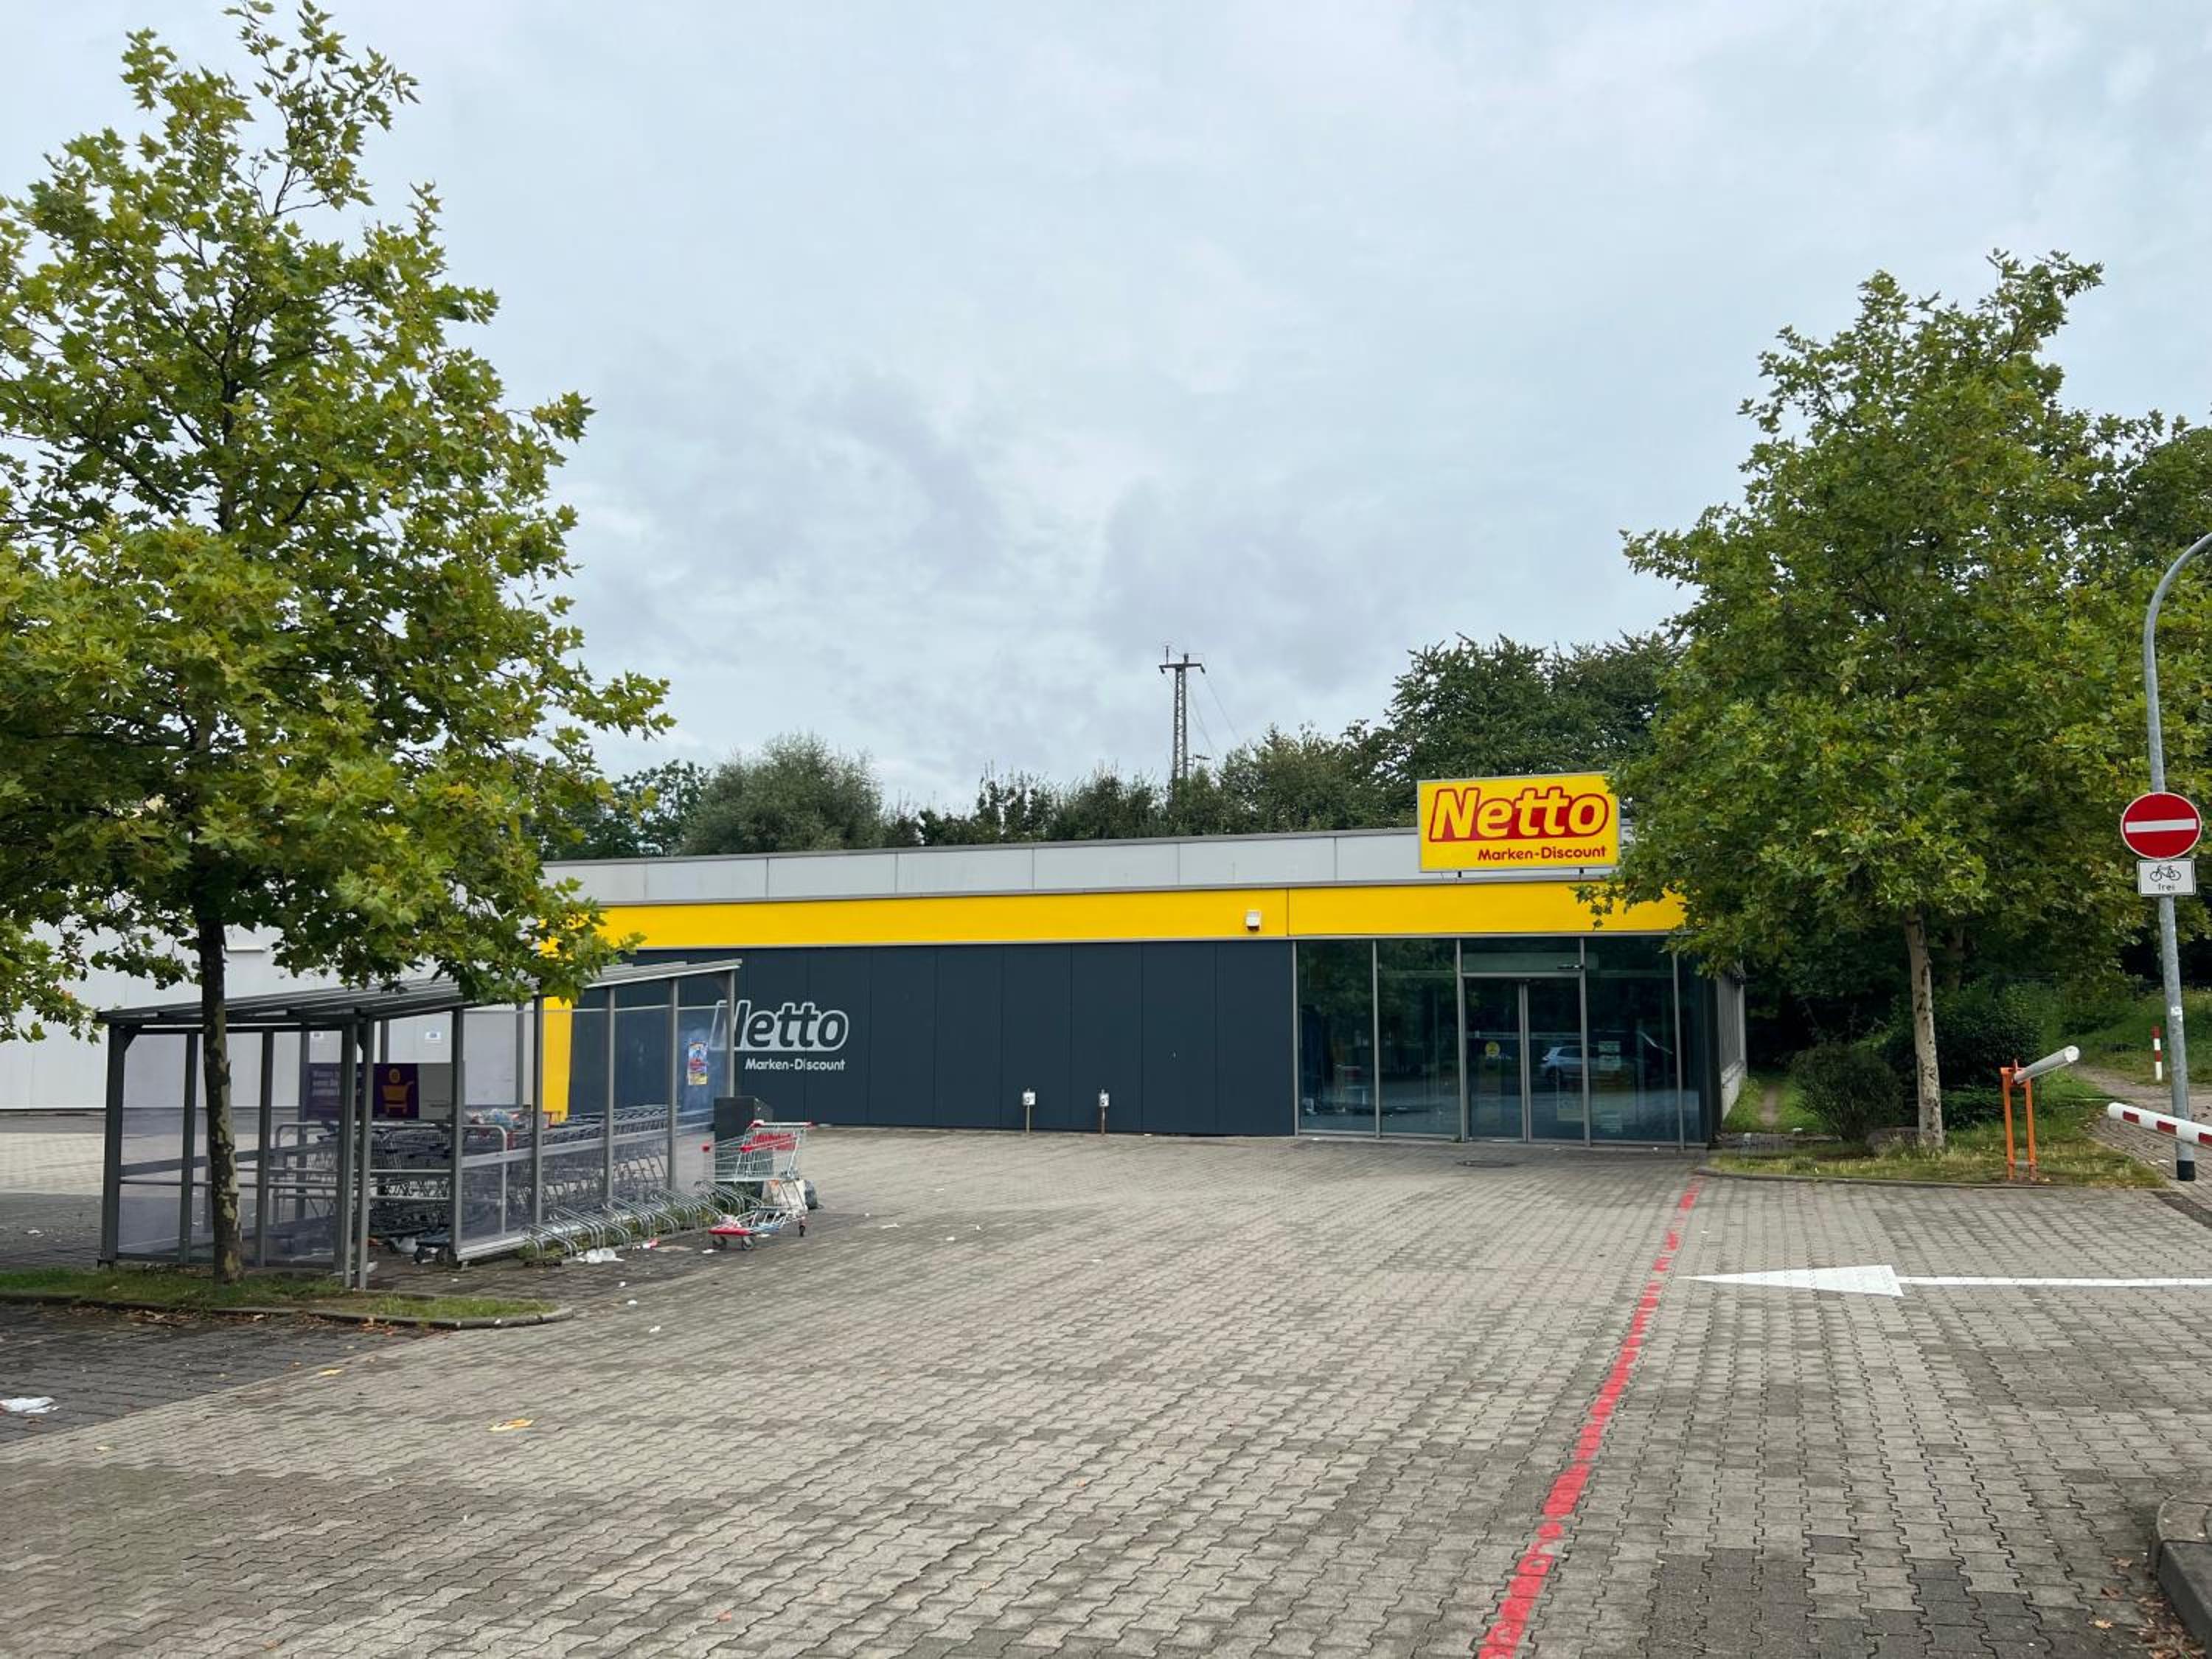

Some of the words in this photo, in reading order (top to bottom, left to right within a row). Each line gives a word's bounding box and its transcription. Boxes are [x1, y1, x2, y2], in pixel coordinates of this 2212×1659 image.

[1429, 786, 1609, 842] Netto
[1478, 846, 1606, 860] Marken-Discount
[709, 999, 849, 1051] Netto
[745, 1058, 846, 1071] Marken-Discount
